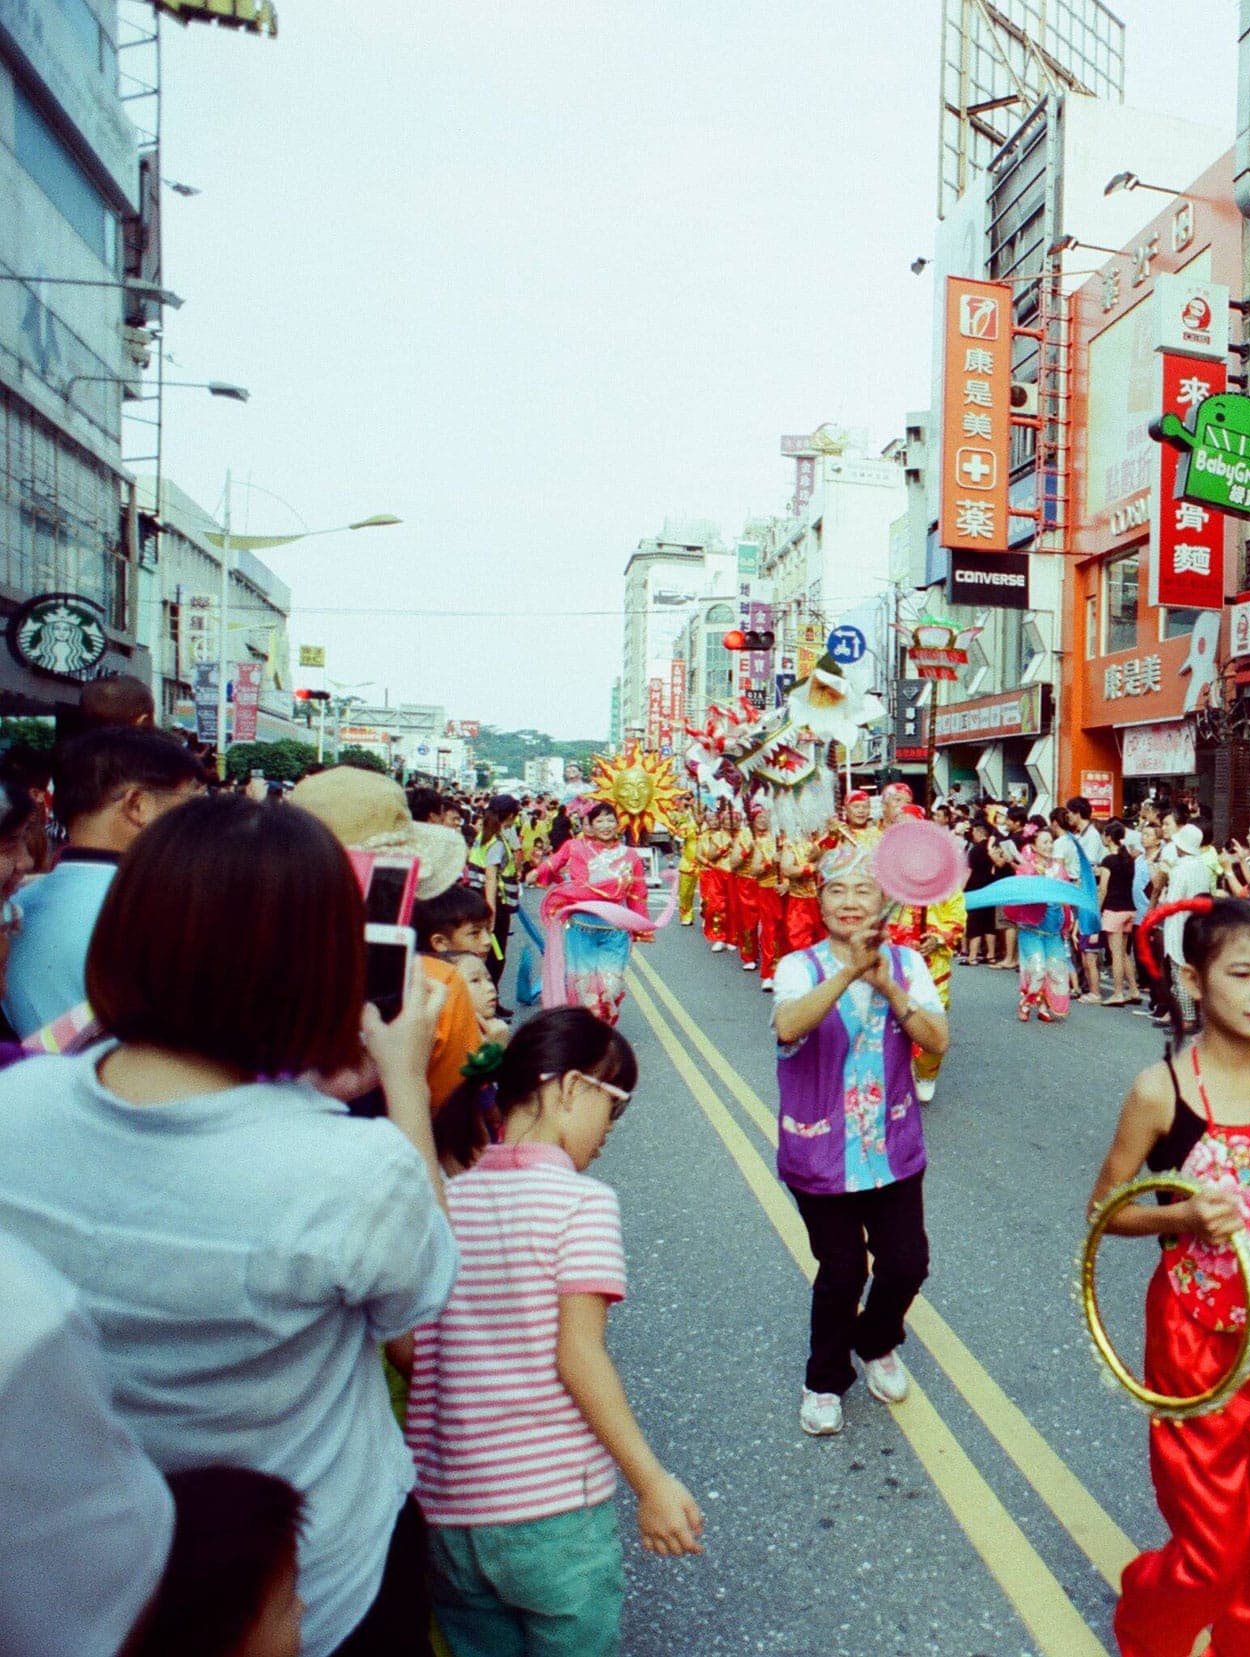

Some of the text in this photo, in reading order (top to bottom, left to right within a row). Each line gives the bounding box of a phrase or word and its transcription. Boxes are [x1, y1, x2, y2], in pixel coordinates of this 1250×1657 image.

[962, 348, 995, 441] 康是美
[955, 569, 1026, 588] CONVERSE
[1103, 654, 1162, 701] 康是美
